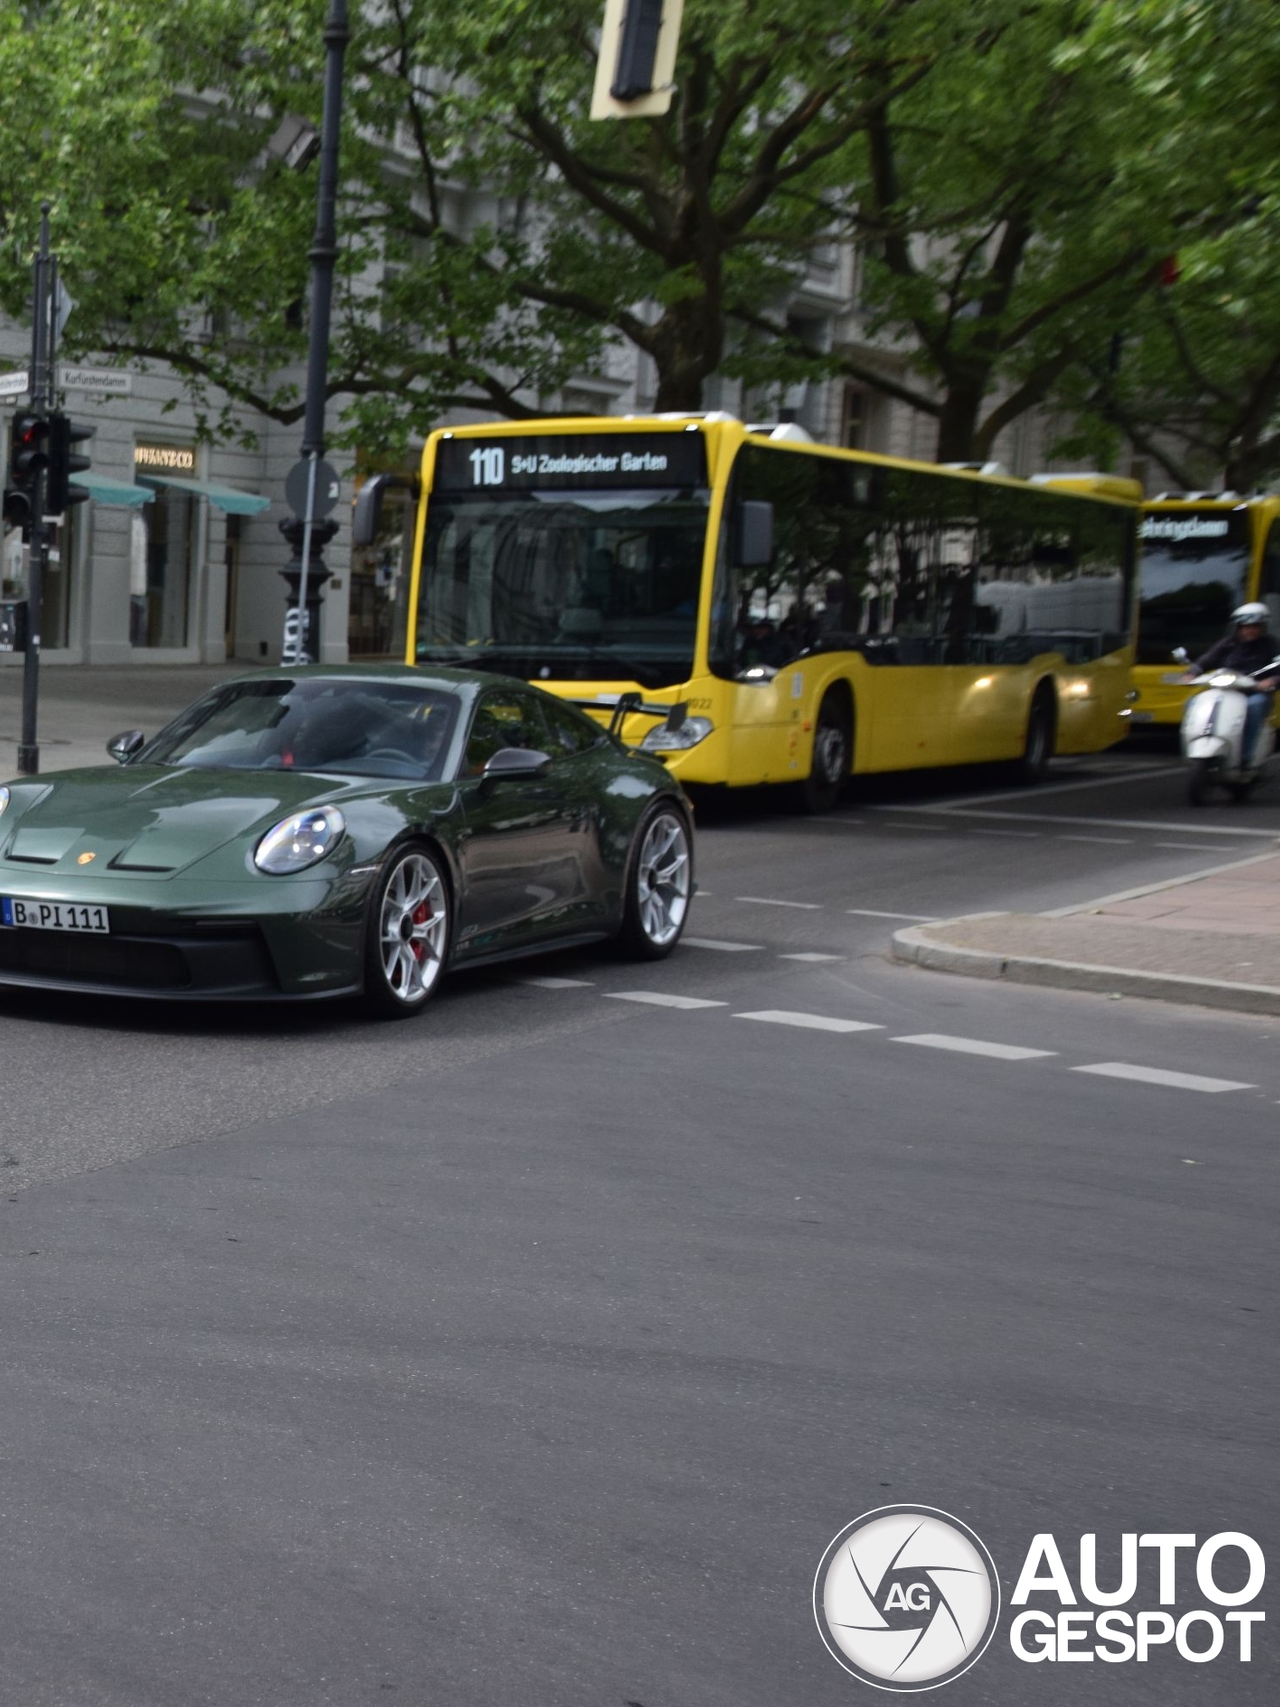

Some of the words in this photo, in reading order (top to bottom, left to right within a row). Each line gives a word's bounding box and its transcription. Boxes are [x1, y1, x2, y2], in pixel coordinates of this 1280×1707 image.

[65, 371, 127, 388] Kurfürstendamm
[470, 447, 505, 486] 110
[538, 453, 619, 474] Zoologischer
[620, 451, 668, 472] Garten
[15, 902, 27, 924] B
[39, 905, 63, 927] PI
[67, 907, 106, 930] 111
